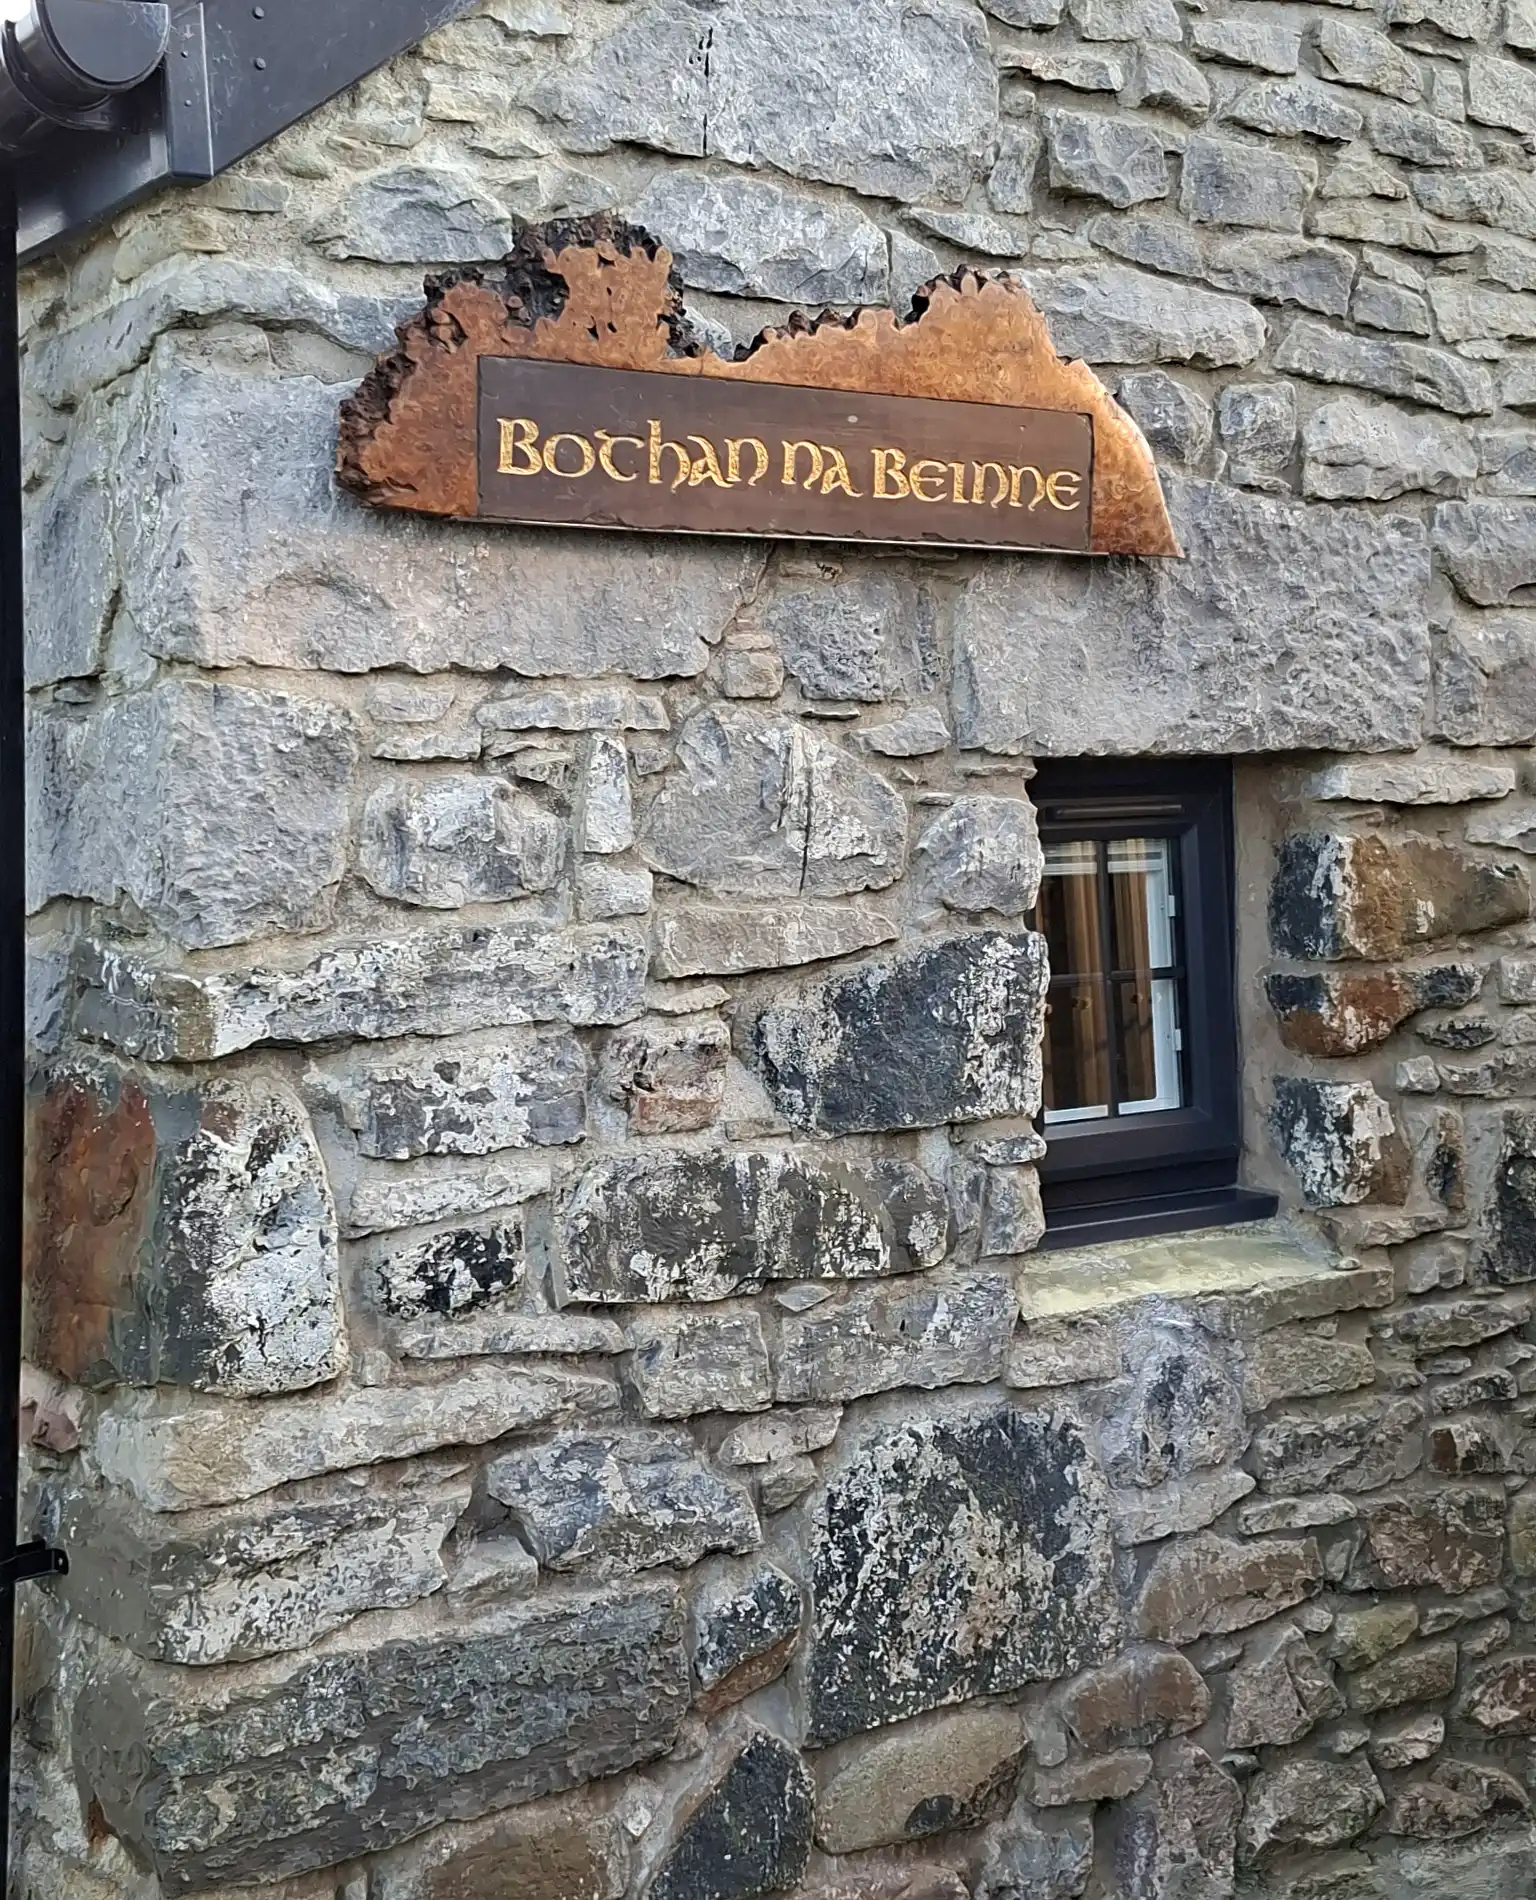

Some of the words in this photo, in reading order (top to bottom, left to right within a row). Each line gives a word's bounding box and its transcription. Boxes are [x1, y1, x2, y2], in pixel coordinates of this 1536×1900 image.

[496, 416, 770, 493] Bothan
[781, 440, 863, 500] na
[871, 448, 1082, 513] Beinne
